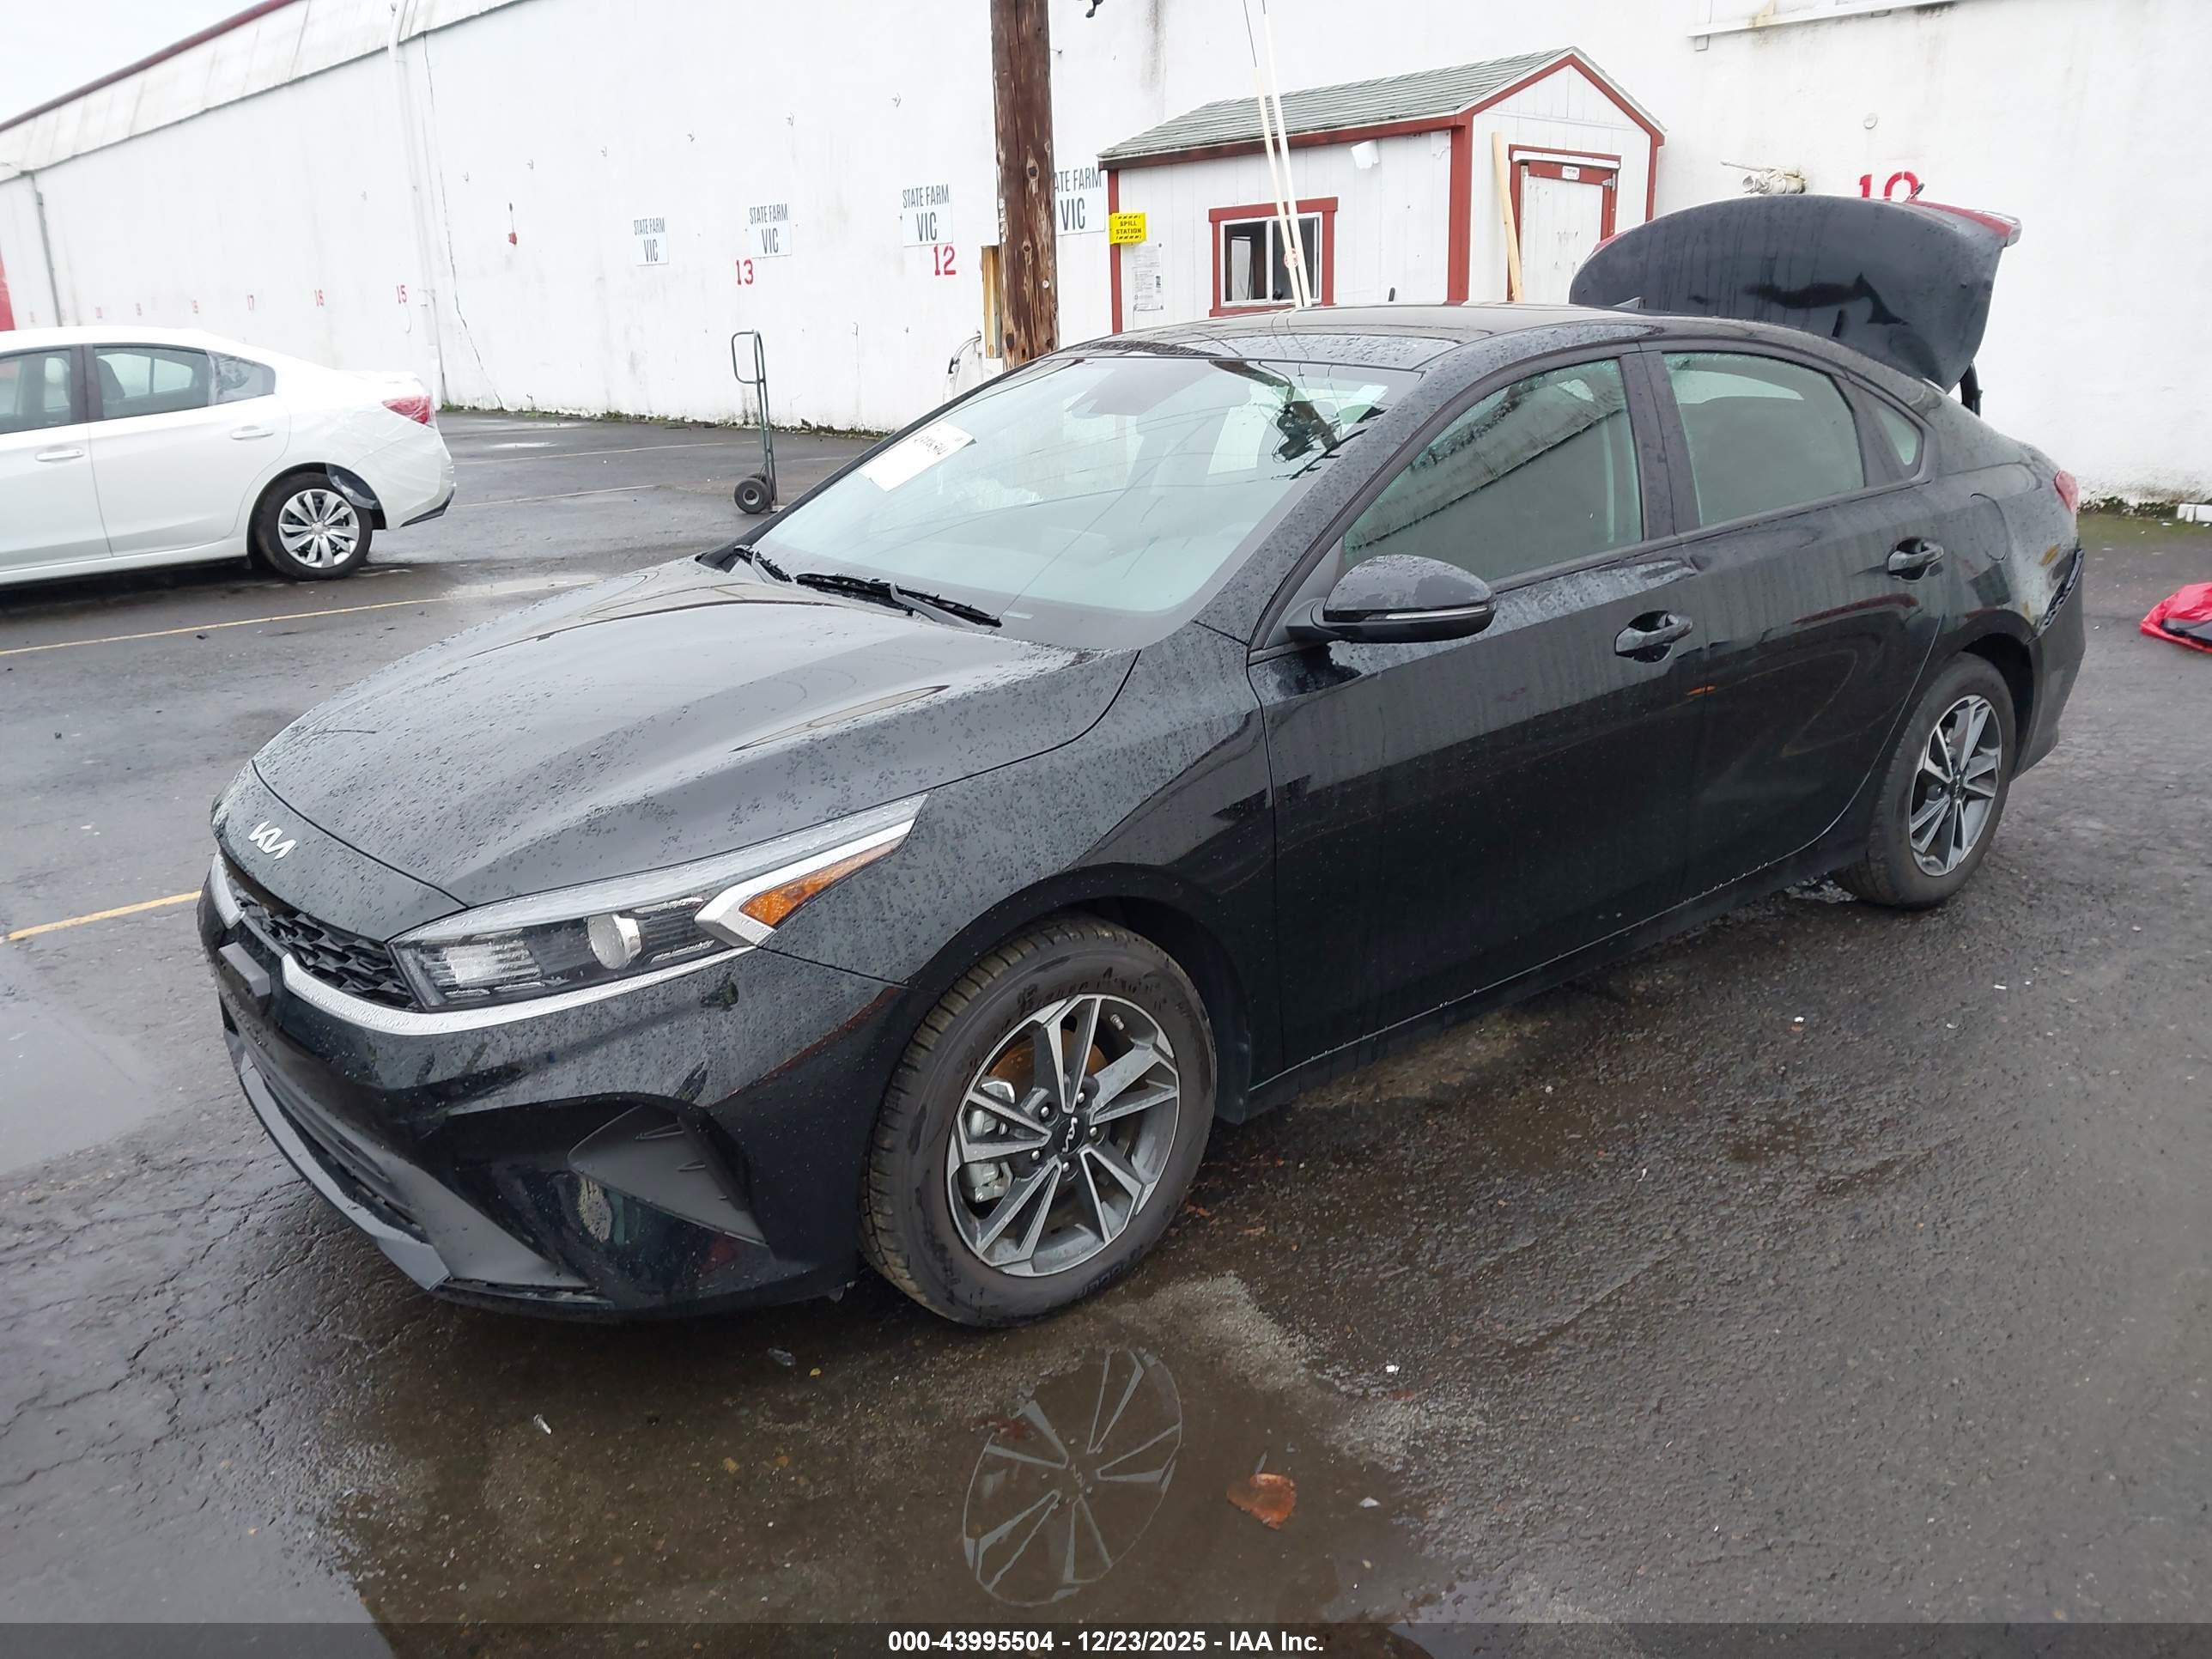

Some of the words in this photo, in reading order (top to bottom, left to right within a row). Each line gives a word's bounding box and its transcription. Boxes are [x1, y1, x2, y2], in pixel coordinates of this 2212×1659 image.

[1054, 170, 1070, 192] ATE
[1073, 167, 1102, 191] FARM
[902, 186, 925, 209] STATE
[926, 183, 950, 205] FARM
[633, 218, 649, 236] STATE
[649, 216, 665, 234] FARM
[749, 205, 767, 225] STATE
[769, 203, 788, 222] FARM
[916, 211, 938, 242] VIC
[1060, 197, 1085, 231] VIC
[643, 239, 659, 263] VIC
[761, 227, 779, 254] VIC
[736, 258, 754, 285] 13
[933, 245, 957, 276] 12
[396, 284, 407, 305] 15
